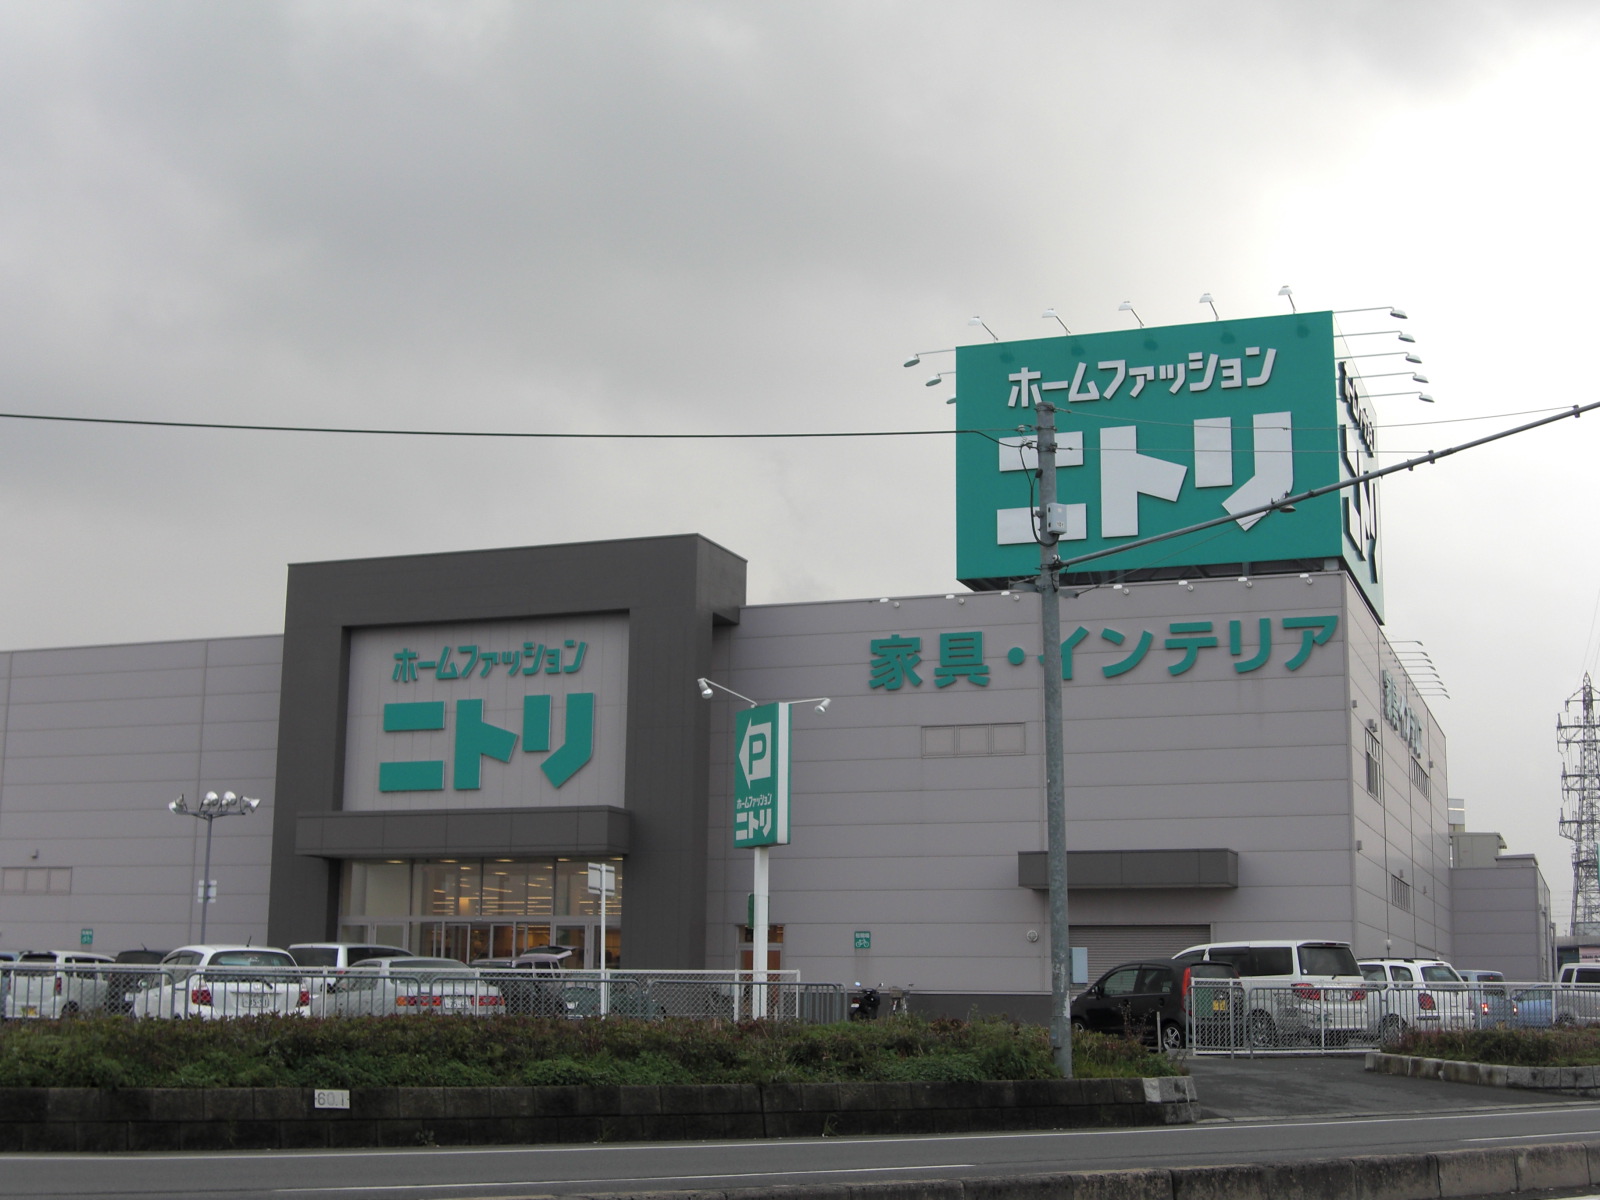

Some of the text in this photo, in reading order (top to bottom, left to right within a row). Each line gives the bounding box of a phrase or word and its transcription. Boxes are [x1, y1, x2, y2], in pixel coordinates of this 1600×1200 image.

[1007, 346, 1277, 408] ホームファッション
[997, 411, 1293, 545] ニトリ
[392, 639, 588, 683] ホームファッション
[379, 692, 595, 793] ニトリ
[749, 733, 767, 775] P
[736, 793, 772, 810] ホームファッション
[736, 808, 772, 841] ニトリ
